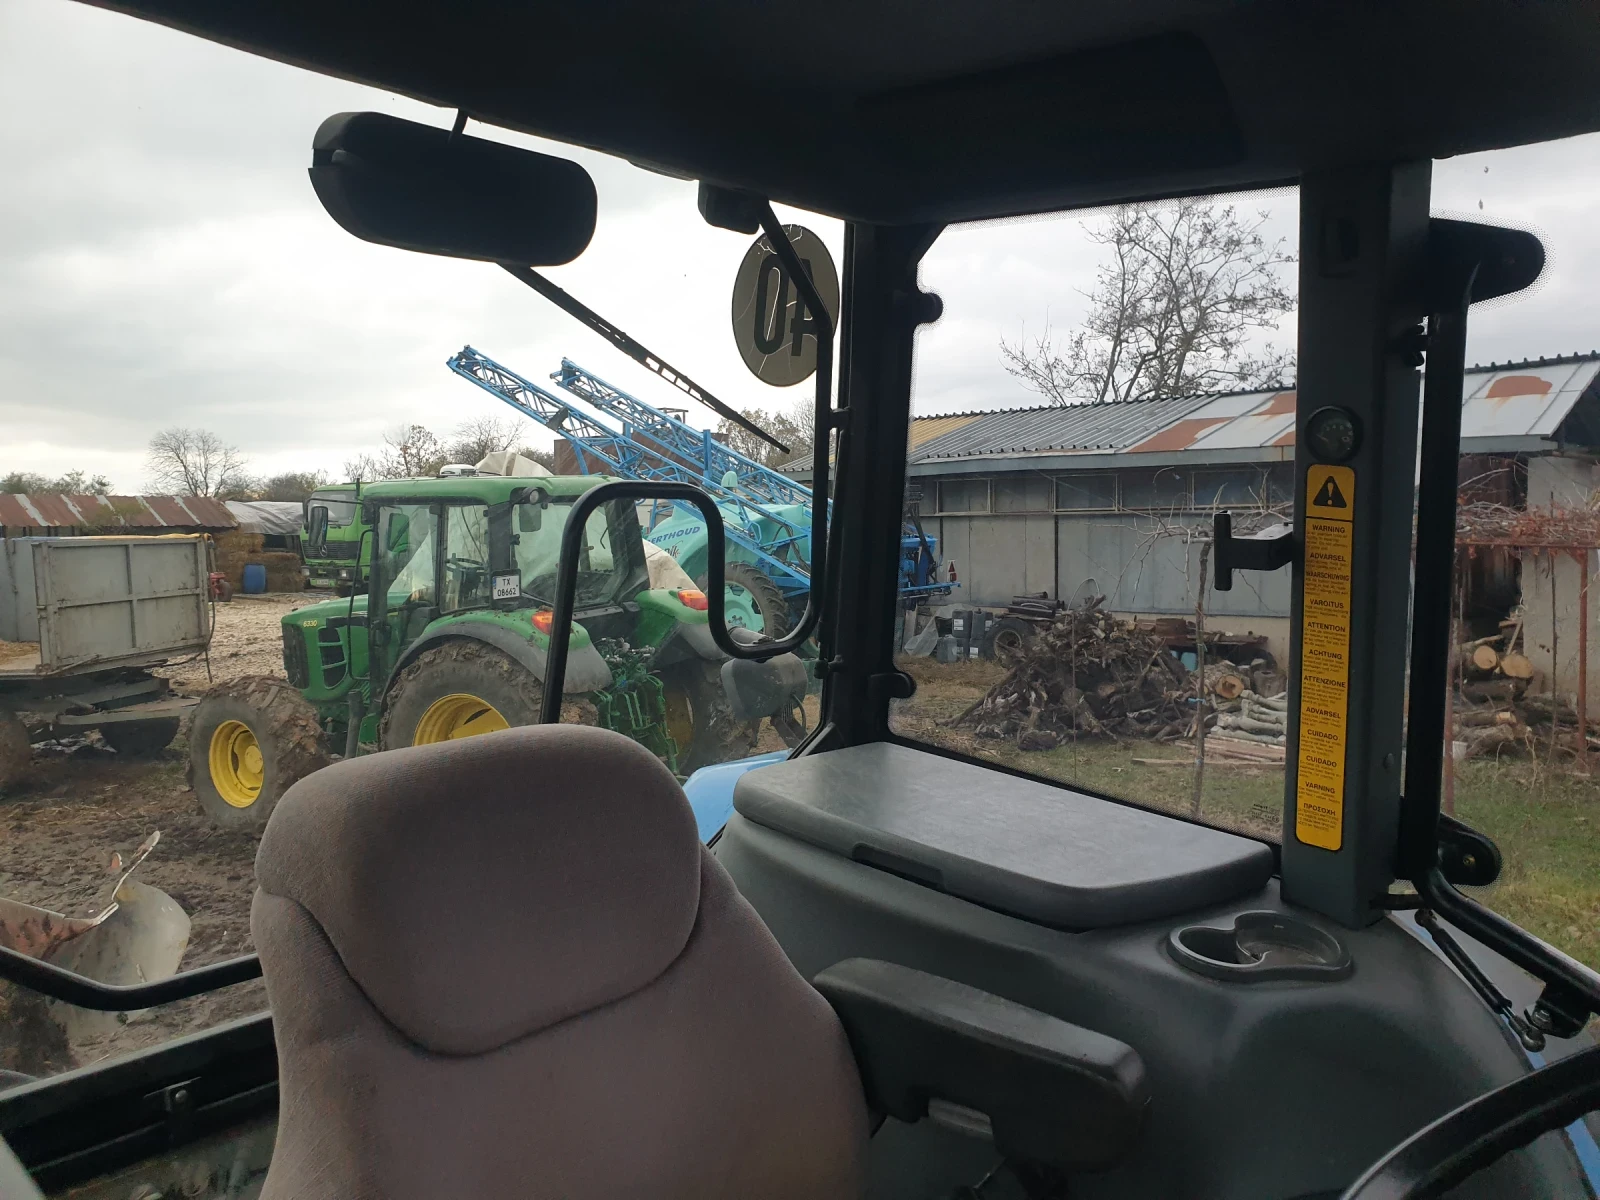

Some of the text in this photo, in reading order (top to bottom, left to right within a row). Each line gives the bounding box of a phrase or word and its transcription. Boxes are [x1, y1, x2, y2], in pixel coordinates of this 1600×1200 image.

[1312, 524, 1345, 533] WARNING
[1310, 552, 1346, 562] ADVARSEL
[502, 577, 511, 586] TX
[1306, 571, 1349, 581] WAARSCHUWING
[497, 587, 516, 596] 08662
[1309, 598, 1344, 609] VAROITUS
[1307, 621, 1346, 632] ATTENTION
[1308, 649, 1342, 659] ACHTUNG
[1304, 675, 1346, 688] ATTENZIONE
[1306, 706, 1341, 719] ADVARSEL
[1307, 728, 1338, 741] CUIDADO
[1305, 755, 1337, 767] CUIDADO
[1305, 781, 1336, 794] VARNING
